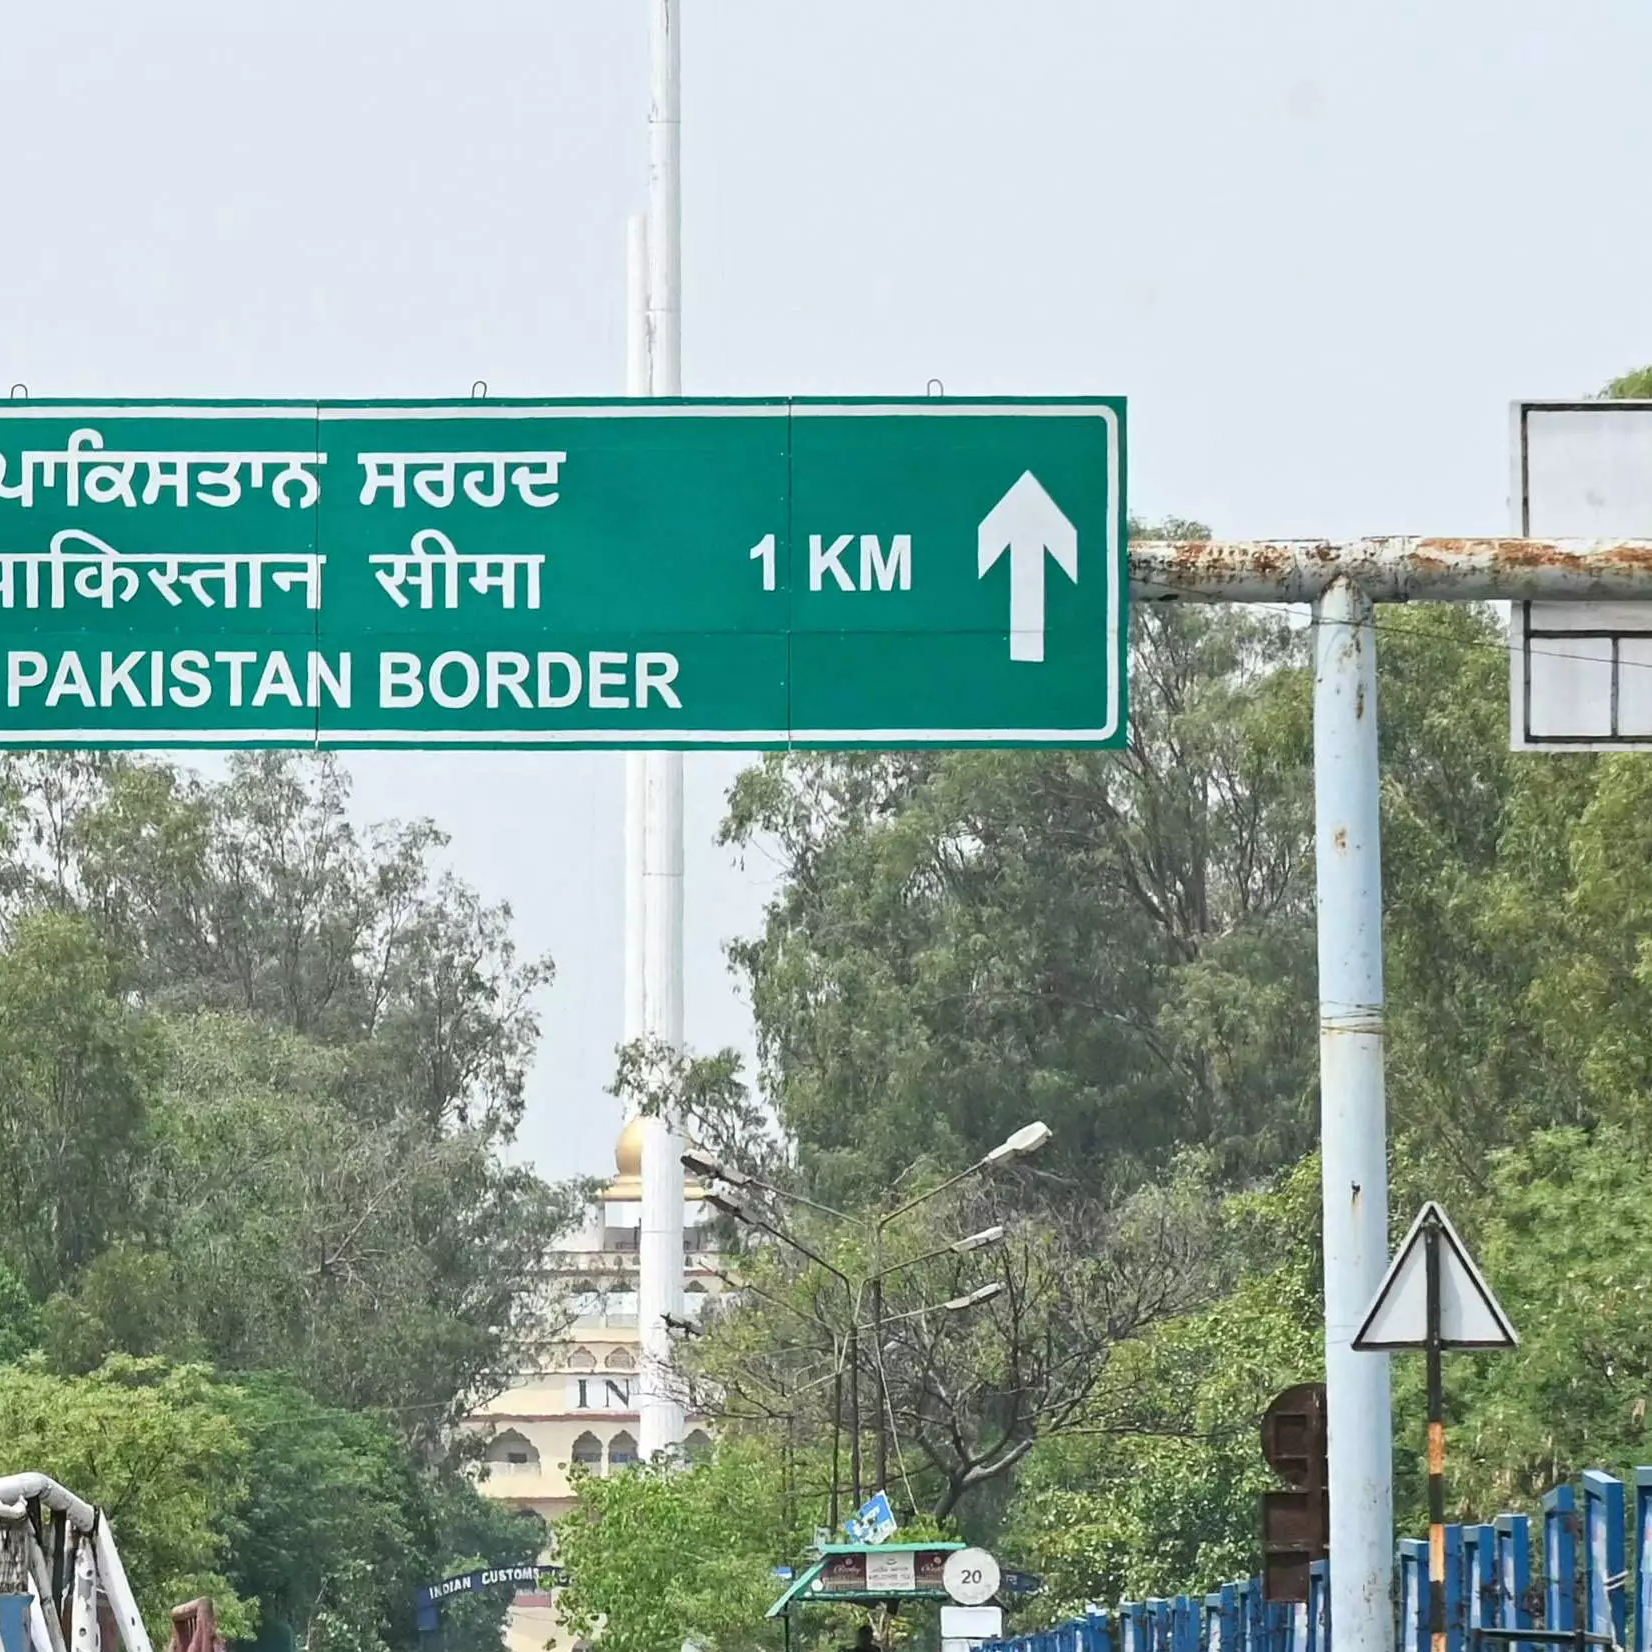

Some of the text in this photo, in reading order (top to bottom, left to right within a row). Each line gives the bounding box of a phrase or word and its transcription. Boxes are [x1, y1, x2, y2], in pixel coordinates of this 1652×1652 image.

[357, 451, 567, 508] ਸਰਹਦ
[368, 528, 546, 609] सीमा
[750, 534, 912, 592] 1 KM
[7, 650, 352, 709] PAKISTAN
[379, 650, 683, 709] BORDER
[428, 1576, 472, 1599] INDIAN
[481, 1567, 540, 1584] CUSTOMS
[960, 1569, 982, 1584] 20
